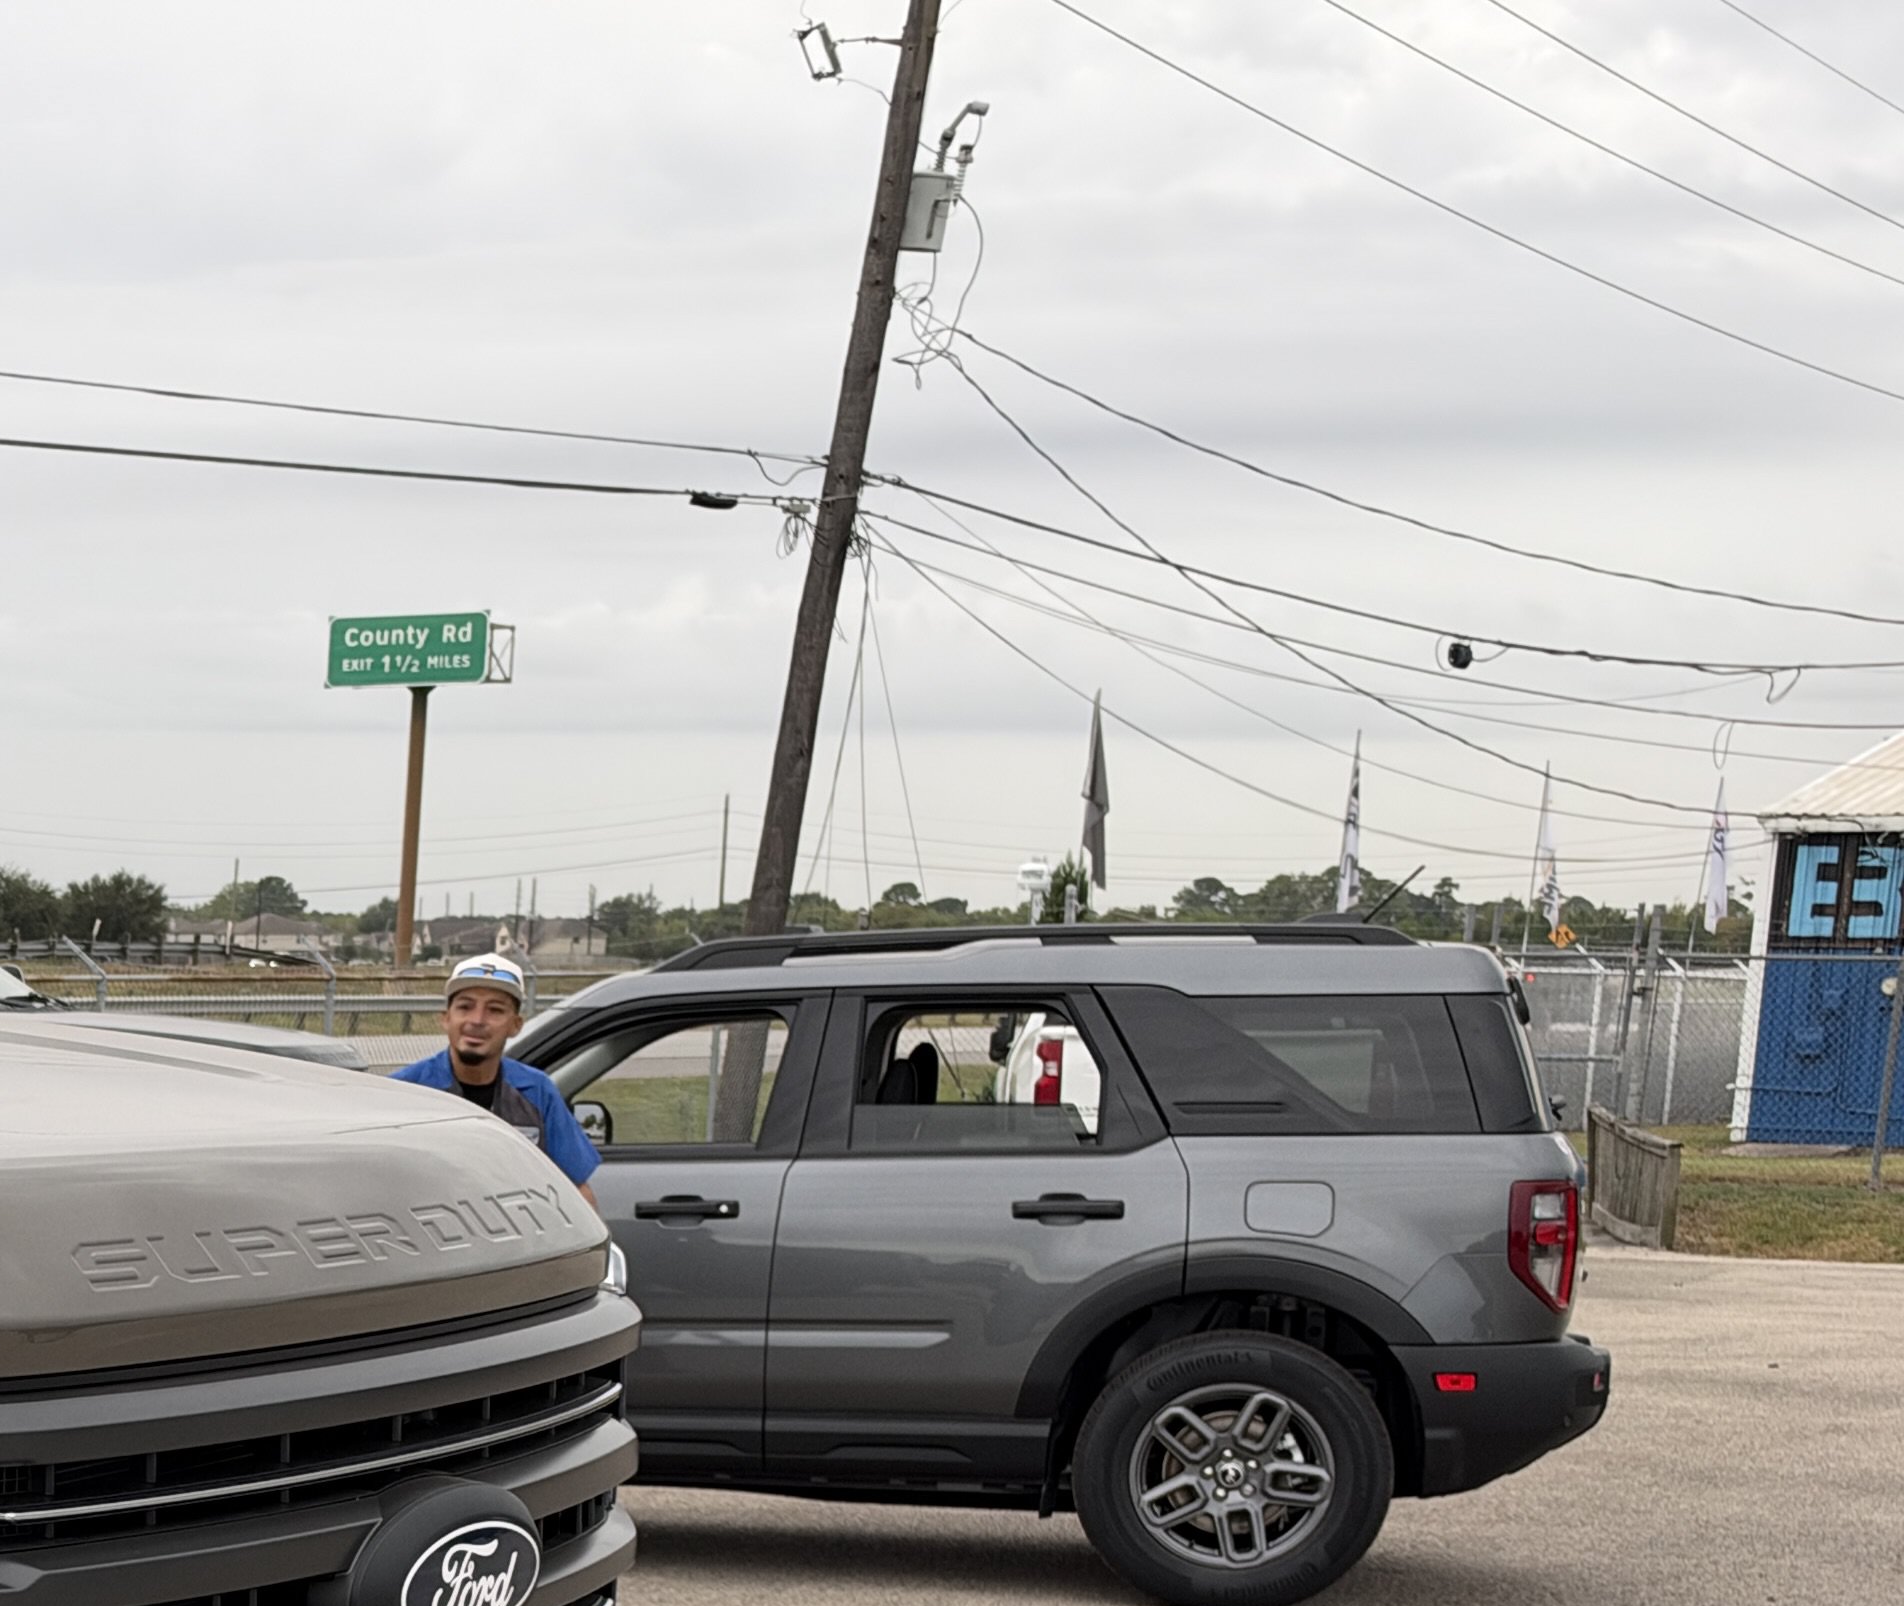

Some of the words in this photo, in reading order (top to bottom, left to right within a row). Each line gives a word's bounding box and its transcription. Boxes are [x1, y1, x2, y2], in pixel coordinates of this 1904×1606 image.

[344, 625, 430, 650] County
[442, 621, 473, 643] Rd
[342, 658, 374, 672] EXIT
[427, 655, 471, 669] MILES
[71, 1211, 420, 1292] SUPER
[408, 1183, 575, 1253] DUTY
